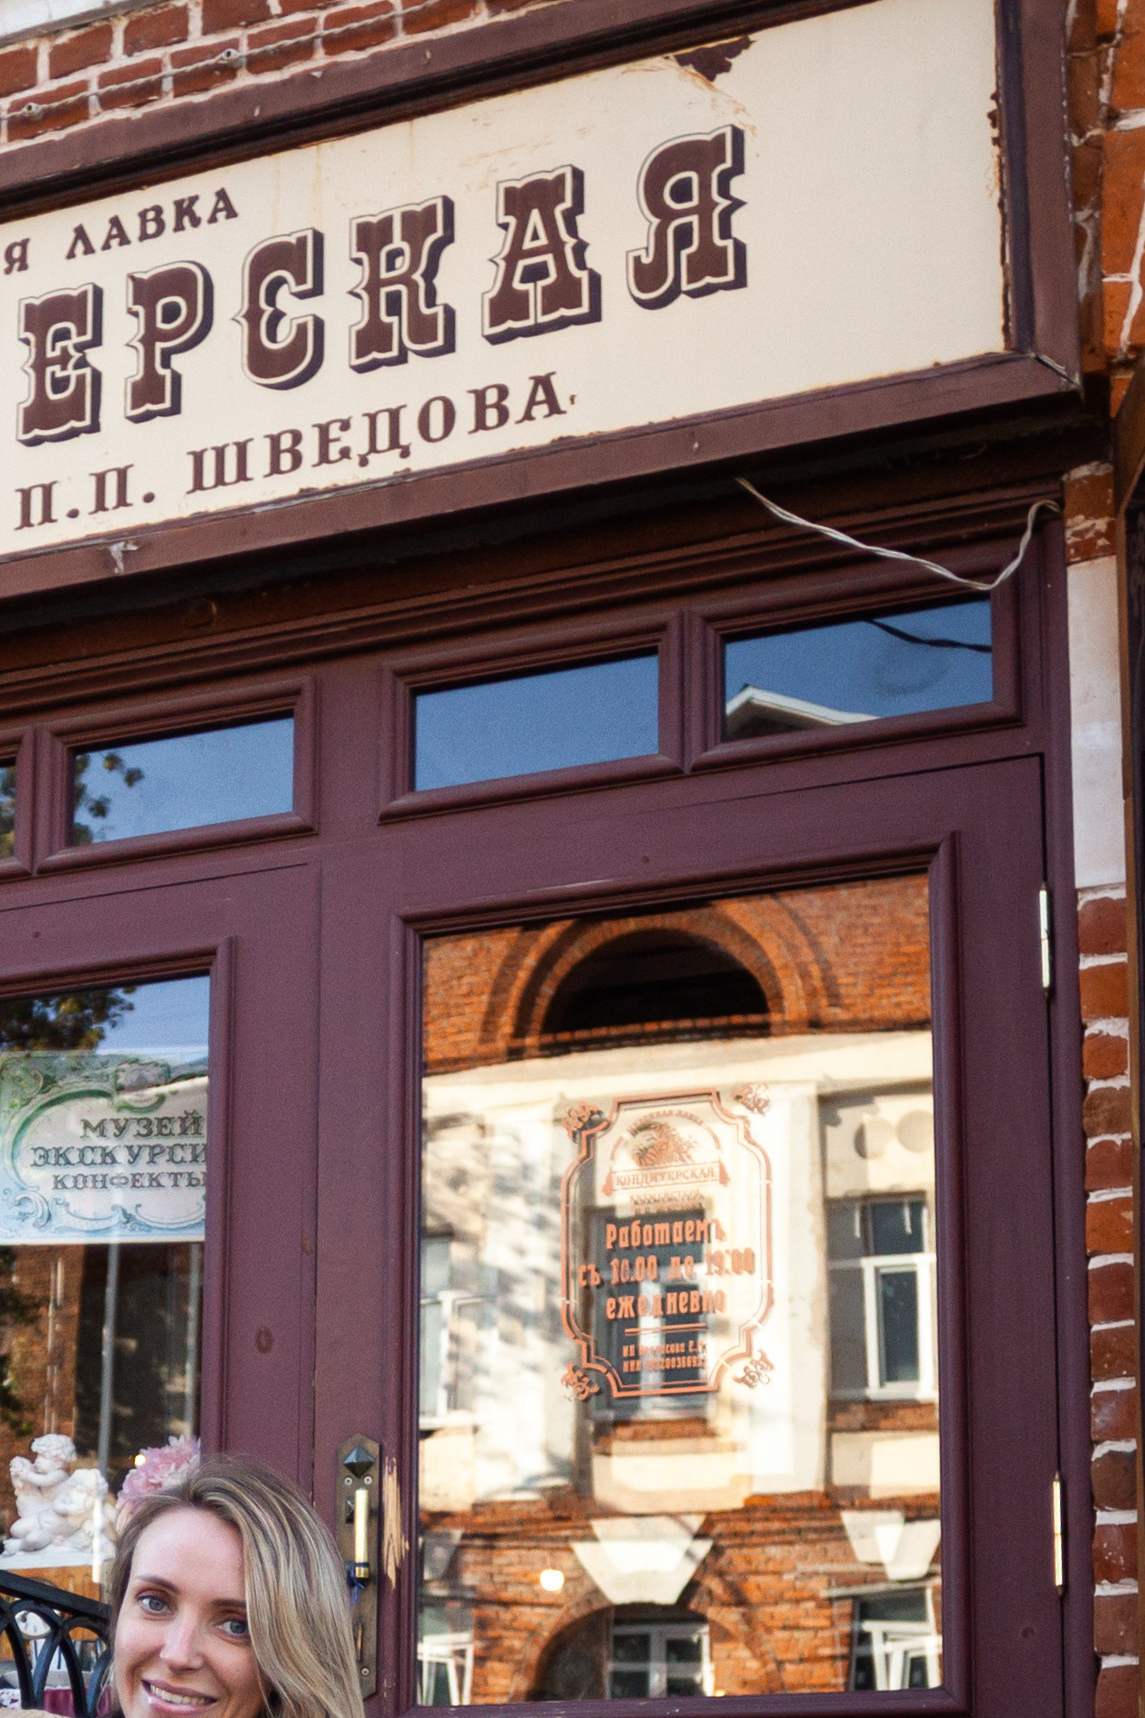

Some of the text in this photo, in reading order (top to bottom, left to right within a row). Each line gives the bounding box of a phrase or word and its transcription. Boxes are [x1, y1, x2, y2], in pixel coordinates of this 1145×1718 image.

[65, 186, 239, 261] ЛАВКА
[14, 464, 157, 531] П.П.
[186, 371, 568, 494] ШВЕДОВА
[80, 1109, 204, 1139] МУЗЕЙ
[606, 1289, 726, 1320] ежедневно
